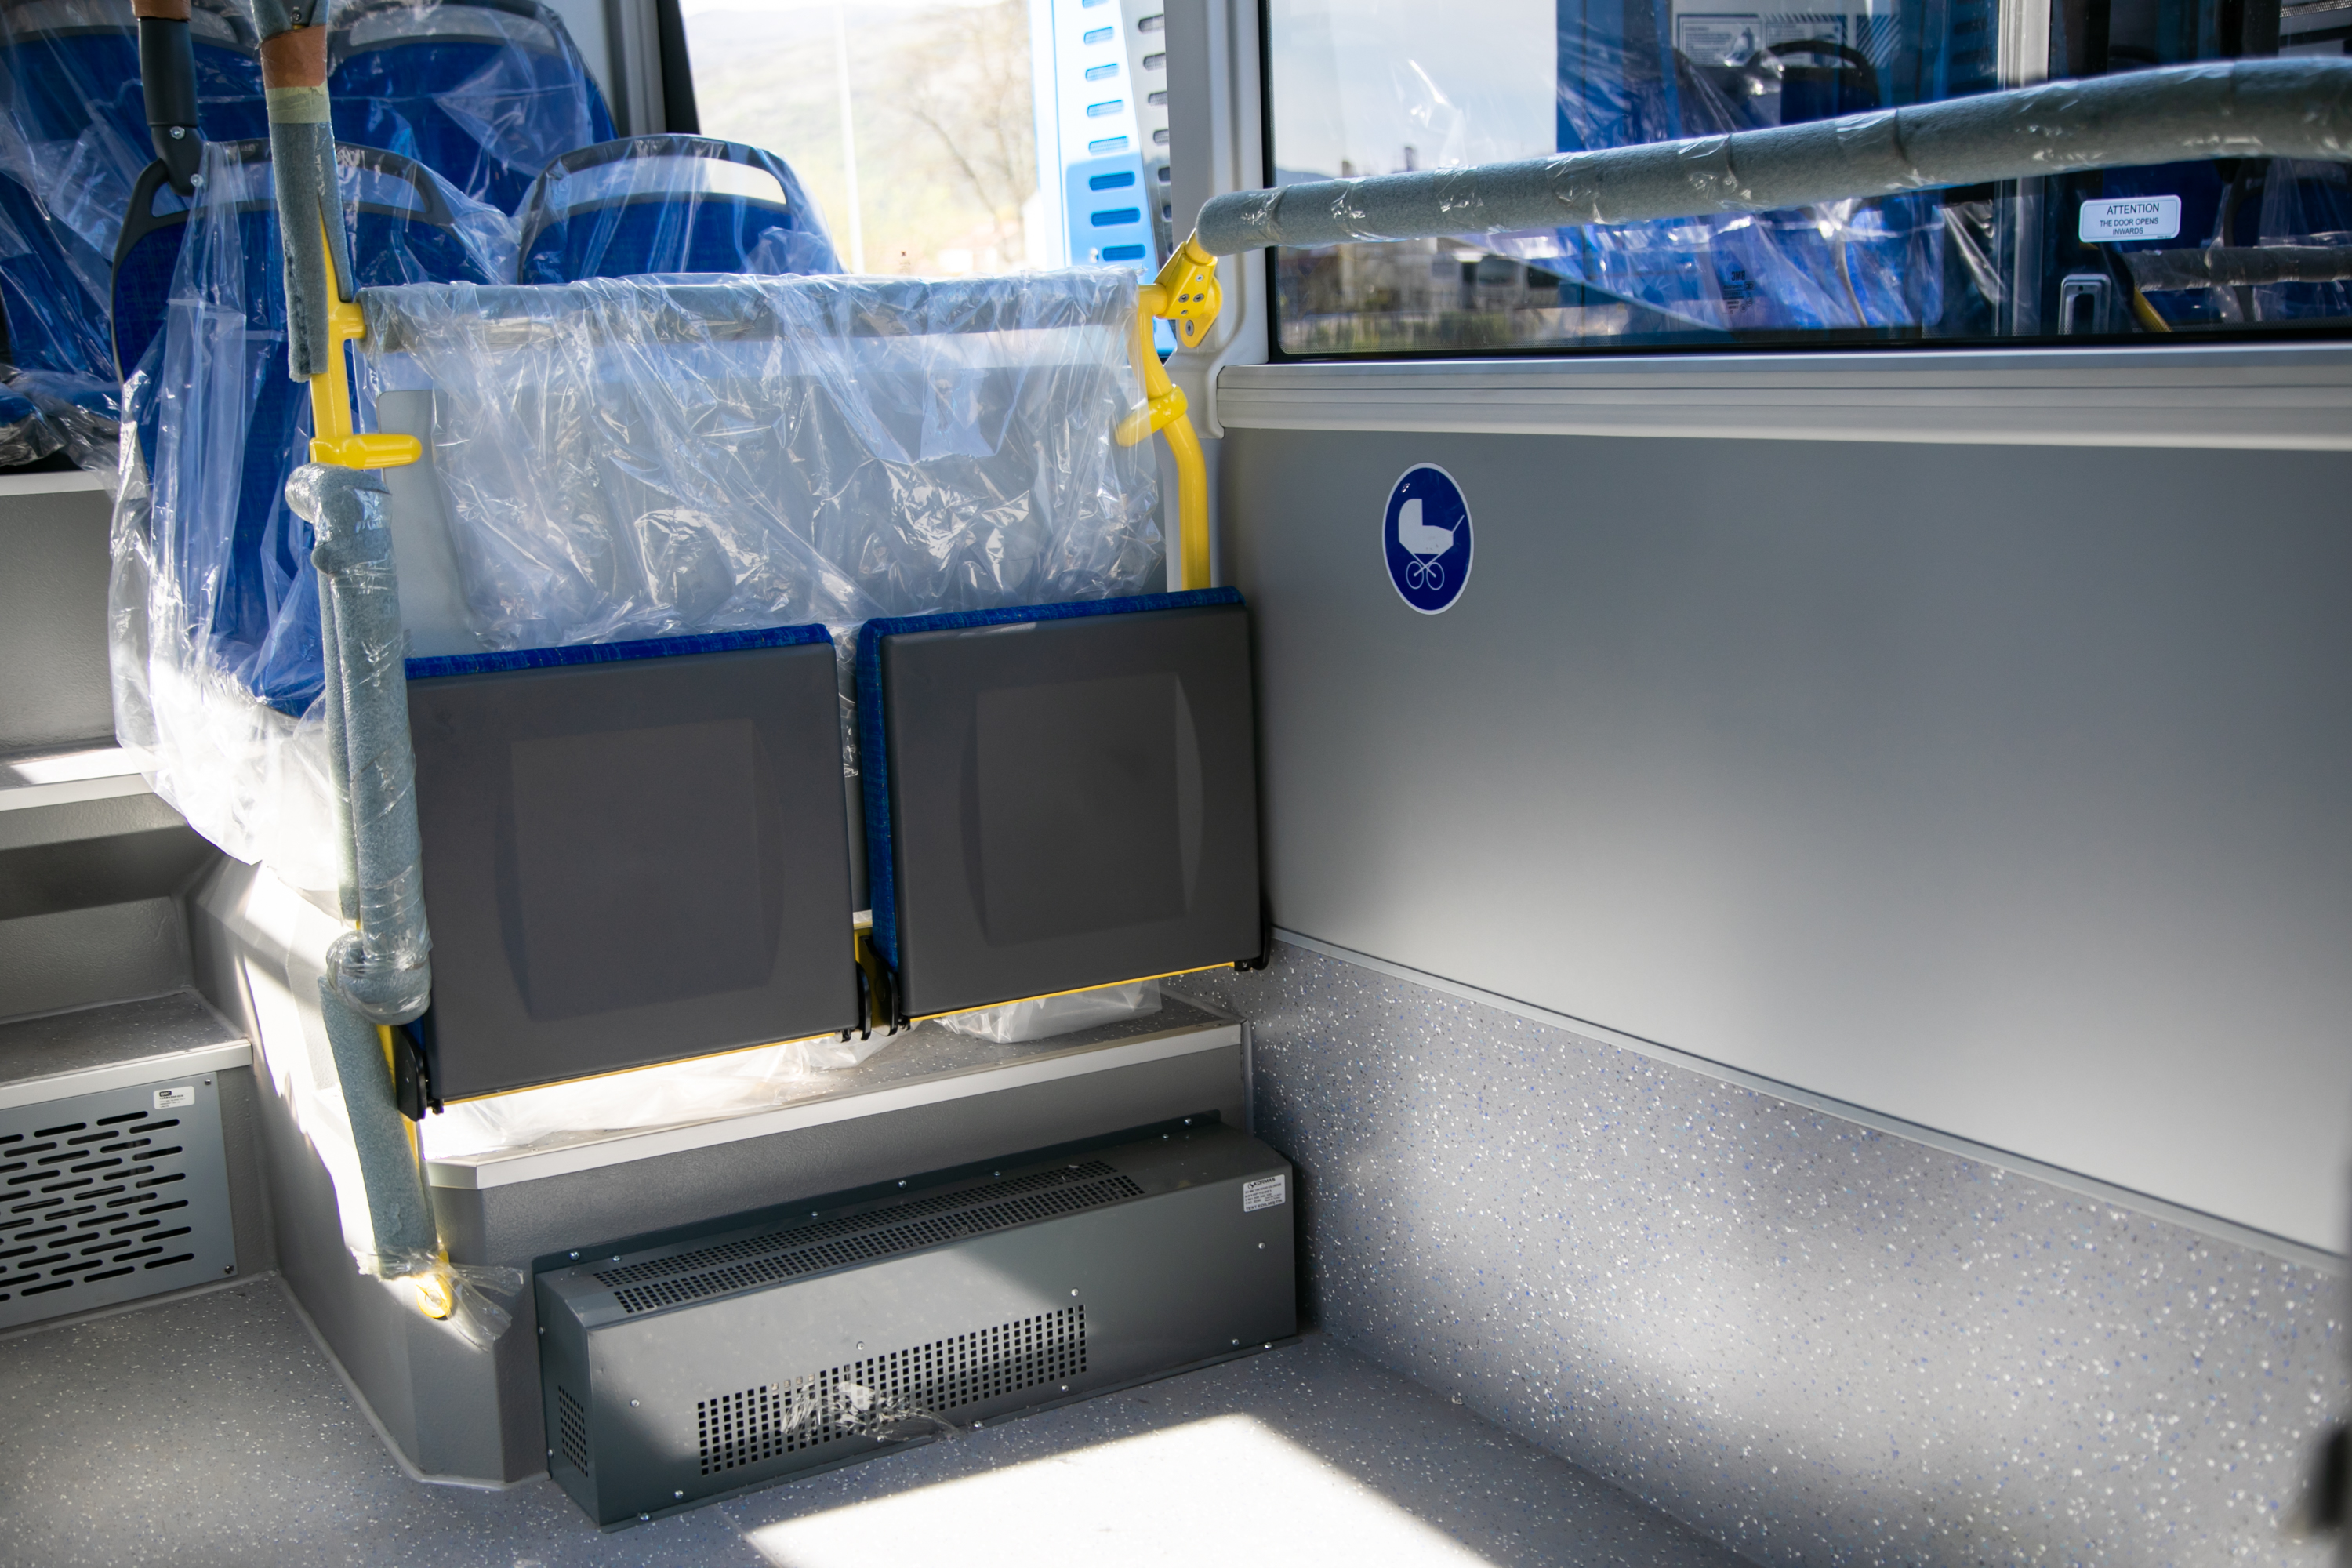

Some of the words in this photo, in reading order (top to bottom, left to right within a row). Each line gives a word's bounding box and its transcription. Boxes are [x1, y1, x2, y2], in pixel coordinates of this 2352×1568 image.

[2107, 202, 2160, 216] ATTENTION
[2135, 217, 2159, 226] OPENS
[2112, 227, 2143, 235] INWARDS
[1254, 1178, 1276, 1186] KORMAS
